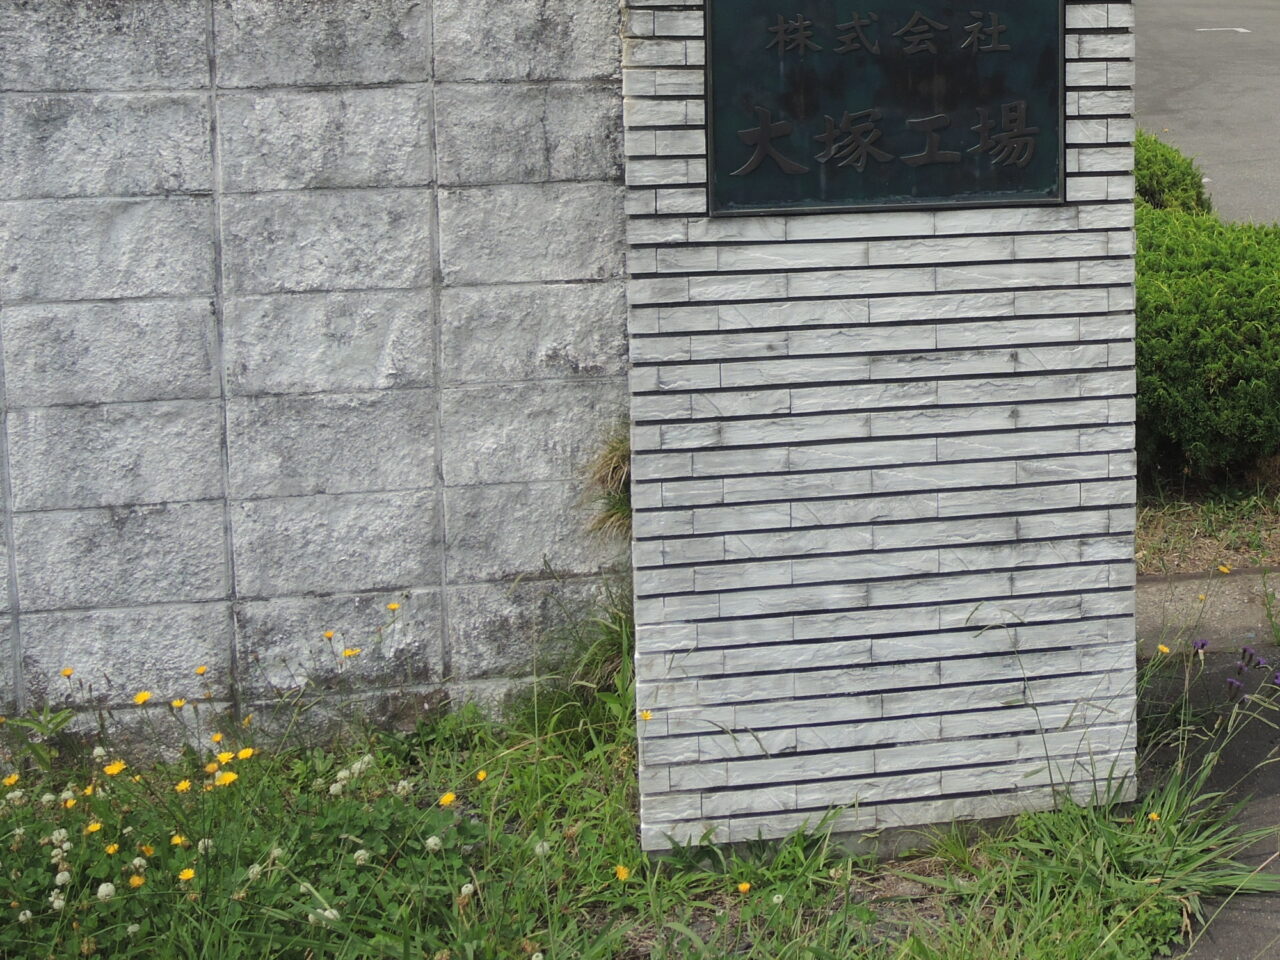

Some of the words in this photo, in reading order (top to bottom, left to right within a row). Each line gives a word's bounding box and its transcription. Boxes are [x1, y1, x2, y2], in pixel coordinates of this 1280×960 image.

[764, 10, 1012, 56] 株式会社
[728, 100, 1041, 177] 大塚工場
